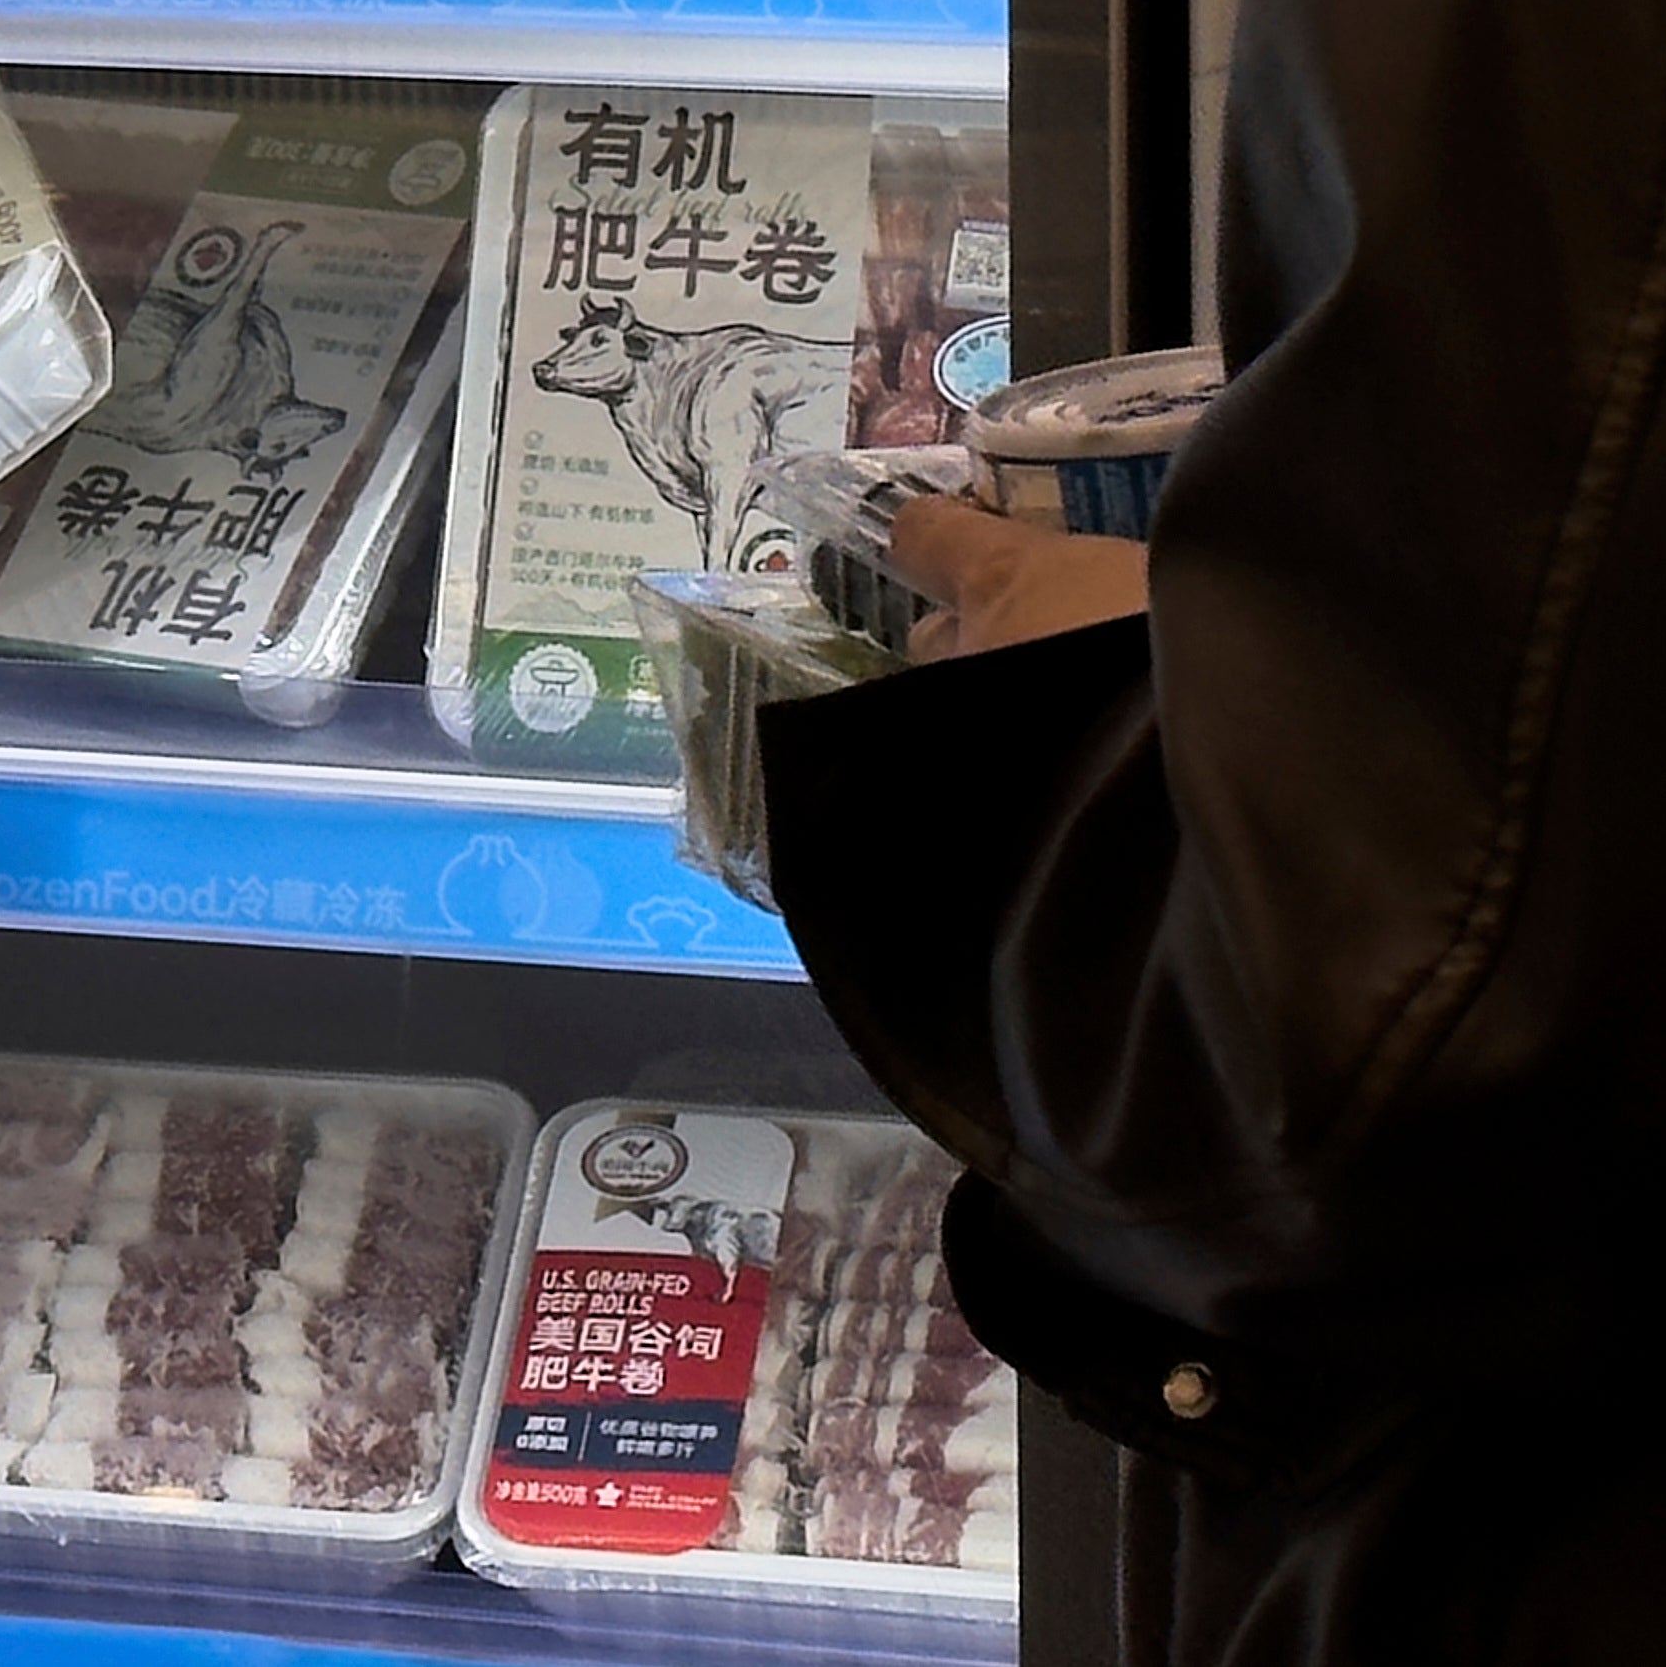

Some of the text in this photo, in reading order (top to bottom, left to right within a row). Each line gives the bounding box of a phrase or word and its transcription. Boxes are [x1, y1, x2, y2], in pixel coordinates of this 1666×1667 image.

[559, 101, 747, 196] 有机
[543, 205, 837, 305] 肥牛卷
[56, 463, 307, 558] 肥牛卷
[89, 558, 247, 647] 有机
[536, 1291, 655, 1315] BEEF ROLLS
[541, 1269, 691, 1295] U.S. GRAIN-FED
[527, 1316, 724, 1361] 美国谷饲
[520, 1355, 666, 1396] 肥牛卷
